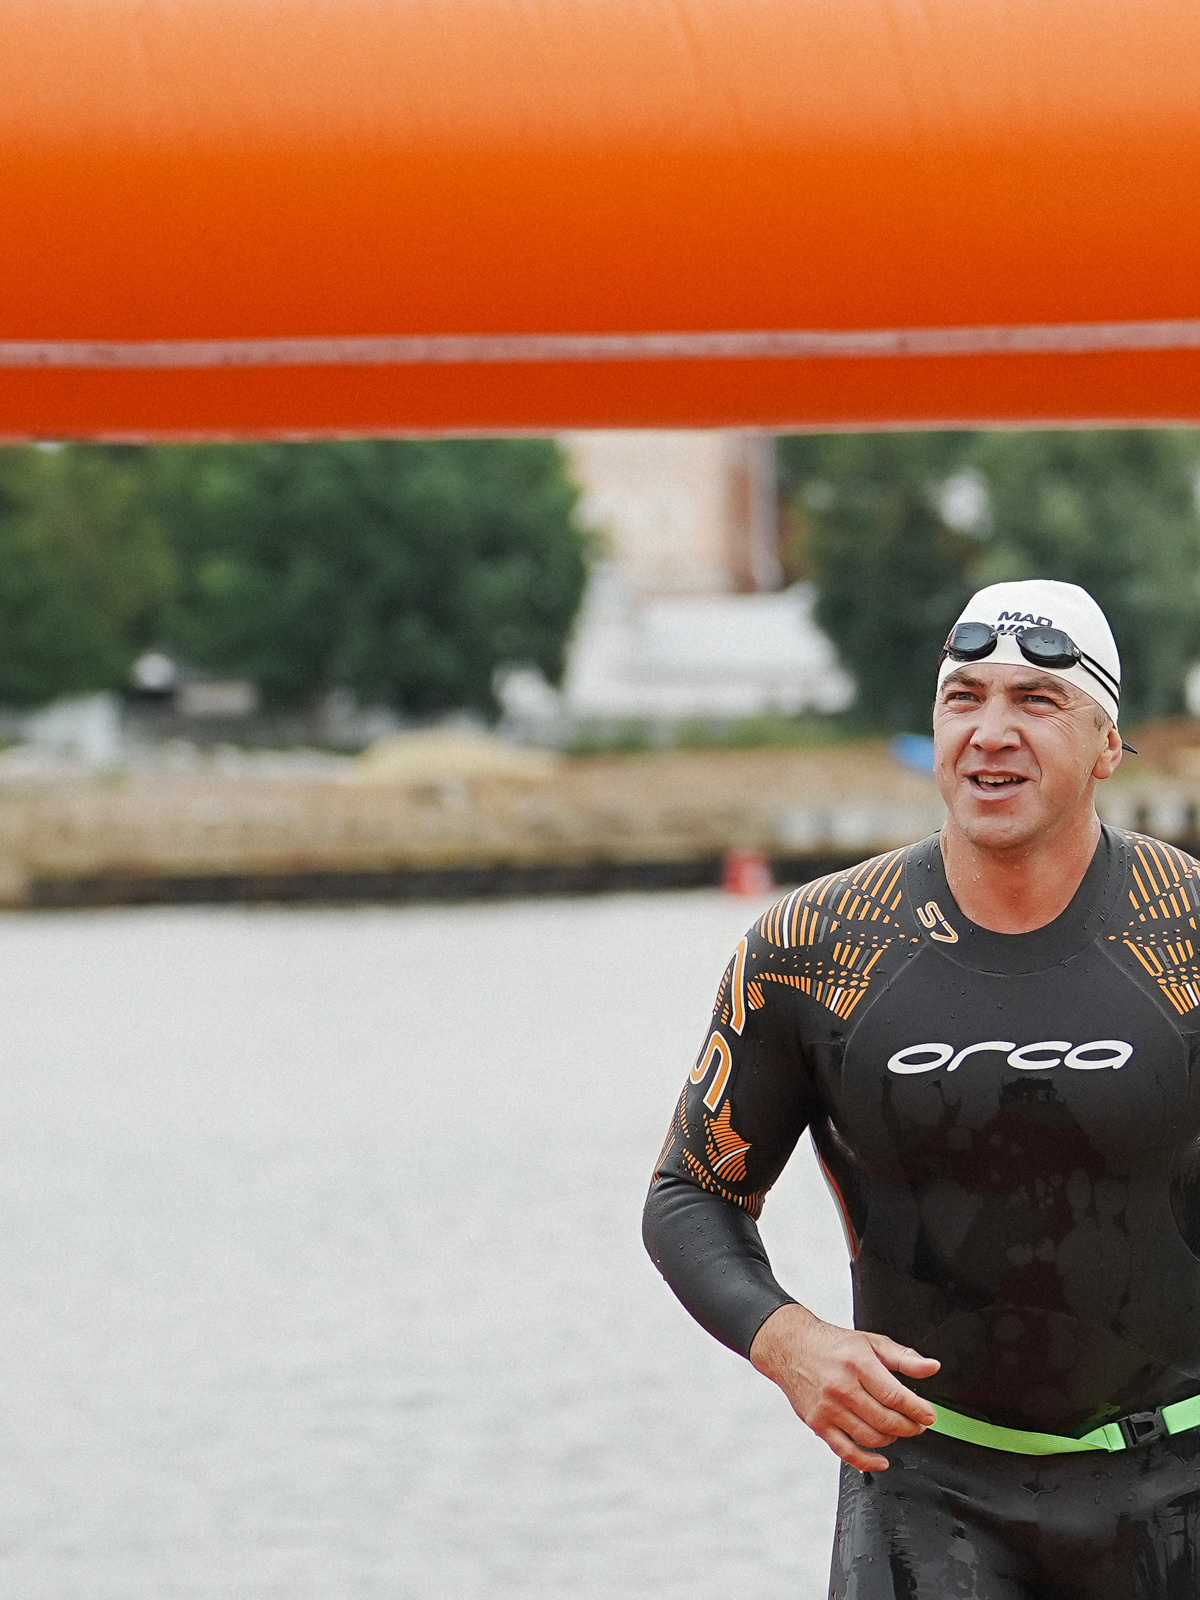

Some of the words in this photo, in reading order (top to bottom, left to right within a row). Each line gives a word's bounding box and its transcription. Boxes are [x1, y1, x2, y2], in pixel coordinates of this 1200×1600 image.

[998, 611, 1053, 628] MAD
[916, 901, 959, 944] S7
[887, 1040, 1134, 1075] orca
